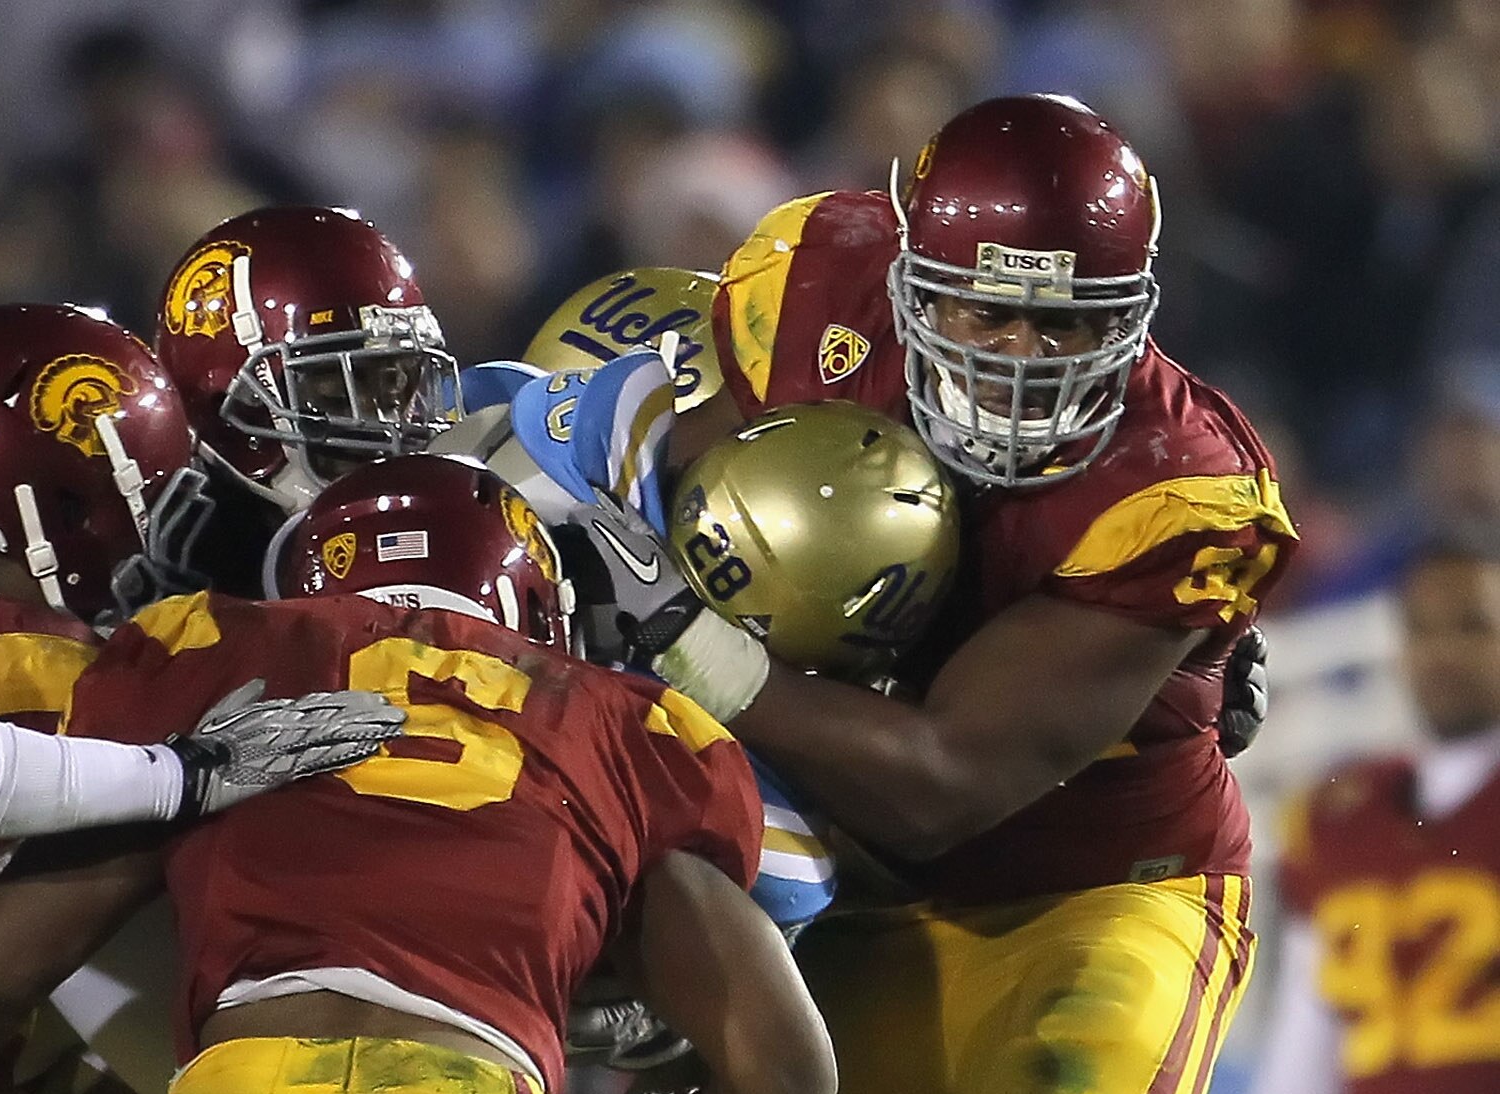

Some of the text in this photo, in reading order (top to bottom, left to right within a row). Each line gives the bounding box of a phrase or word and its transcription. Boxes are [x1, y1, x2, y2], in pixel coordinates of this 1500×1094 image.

[1002, 253, 1052, 271] USC
[684, 523, 752, 602] 28
[1313, 868, 1500, 1077] 92
